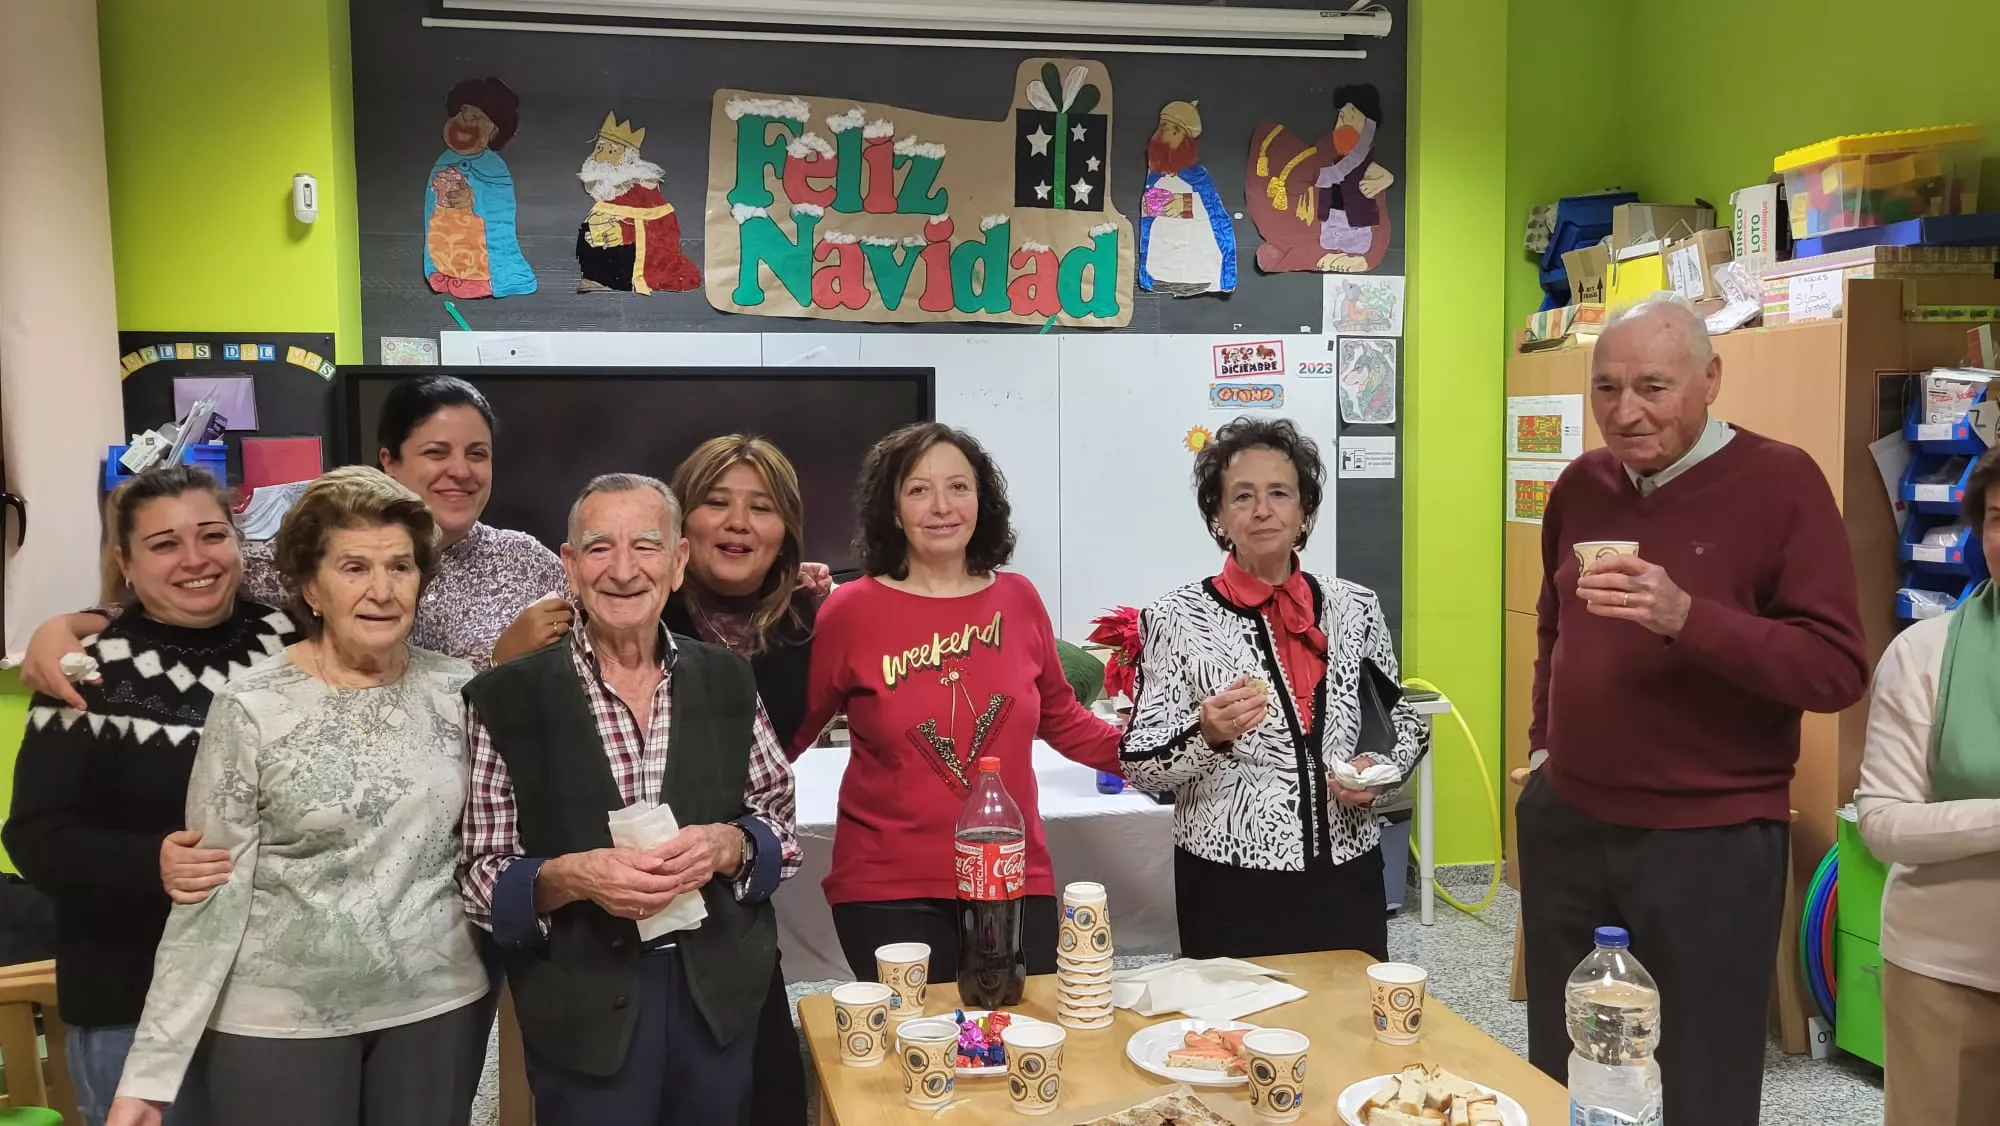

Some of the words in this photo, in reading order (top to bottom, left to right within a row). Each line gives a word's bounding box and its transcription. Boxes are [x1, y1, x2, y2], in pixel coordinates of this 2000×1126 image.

[726, 98, 949, 214] Feliz
[1751, 214, 1760, 254] LOTO
[731, 203, 1120, 318] Navidad
[226, 345, 273, 358] DEL
[1221, 360, 1278, 375] DICIEMBRE
[1298, 362, 1333, 374] 2023
[882, 610, 1003, 688] weekend
